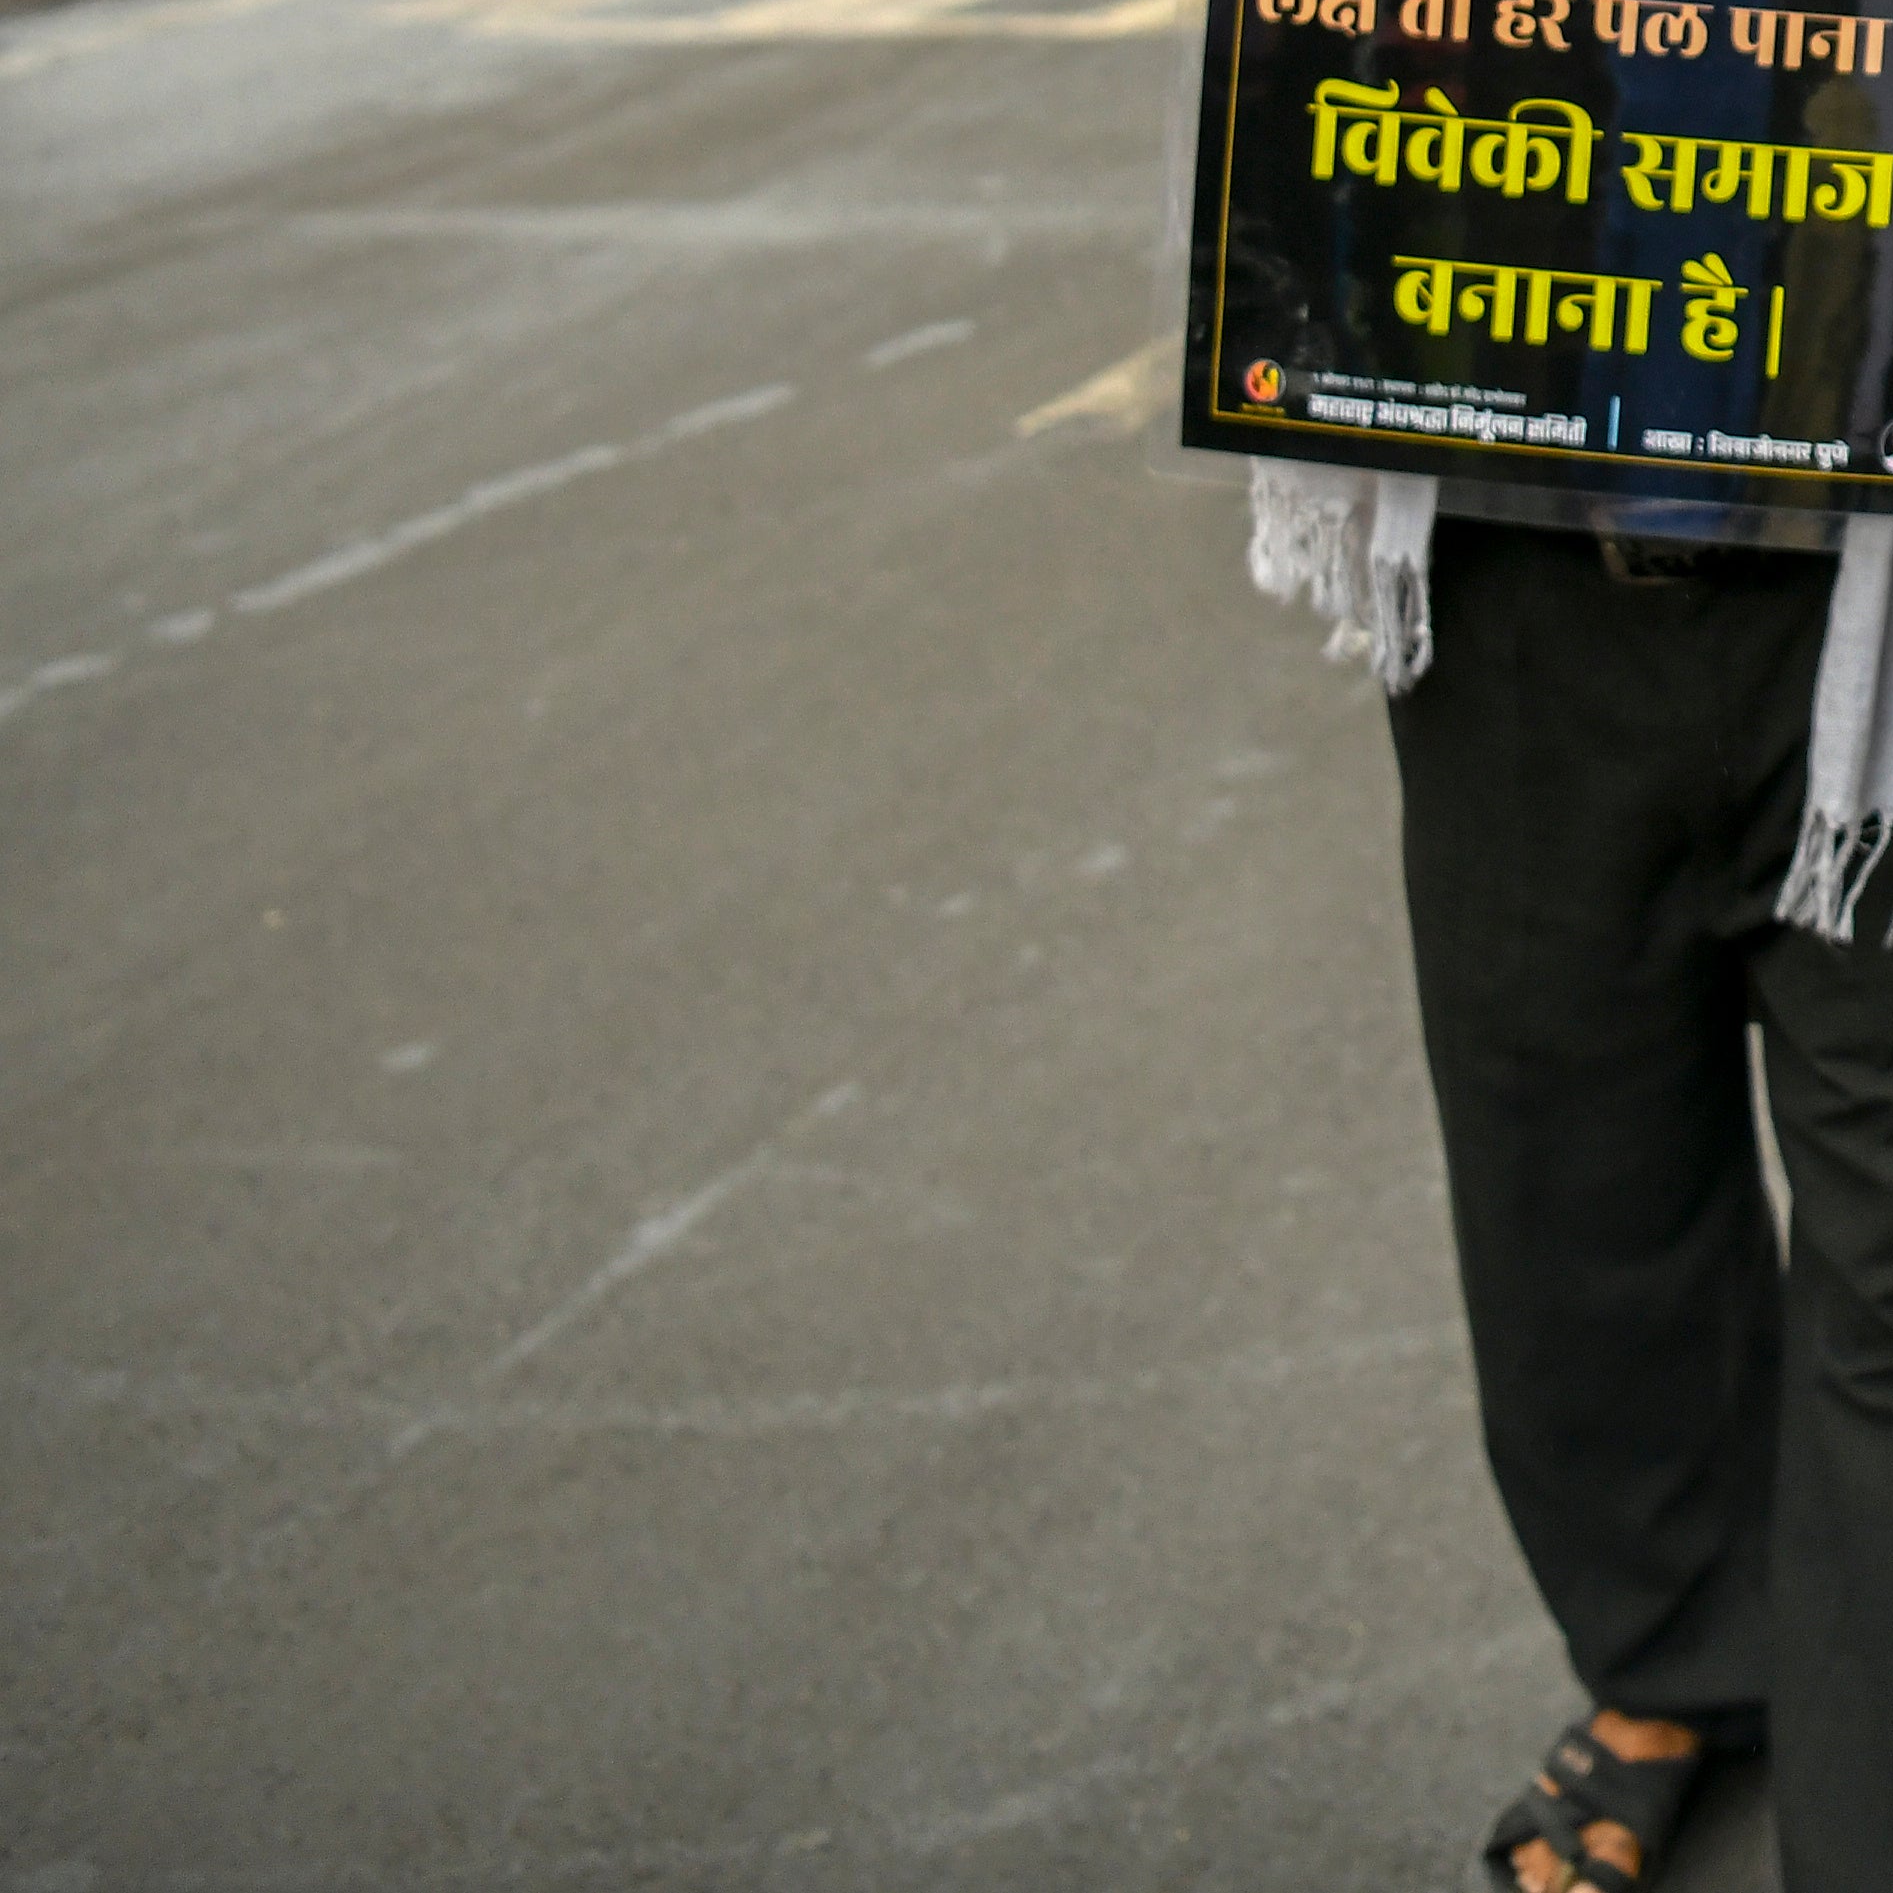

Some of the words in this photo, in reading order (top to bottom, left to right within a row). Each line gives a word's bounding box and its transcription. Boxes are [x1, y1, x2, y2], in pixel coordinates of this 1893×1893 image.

[1731, 6, 1892, 77] पाना
[1306, 78, 1604, 204] विवेकी
[1392, 254, 1663, 356] बनाना
